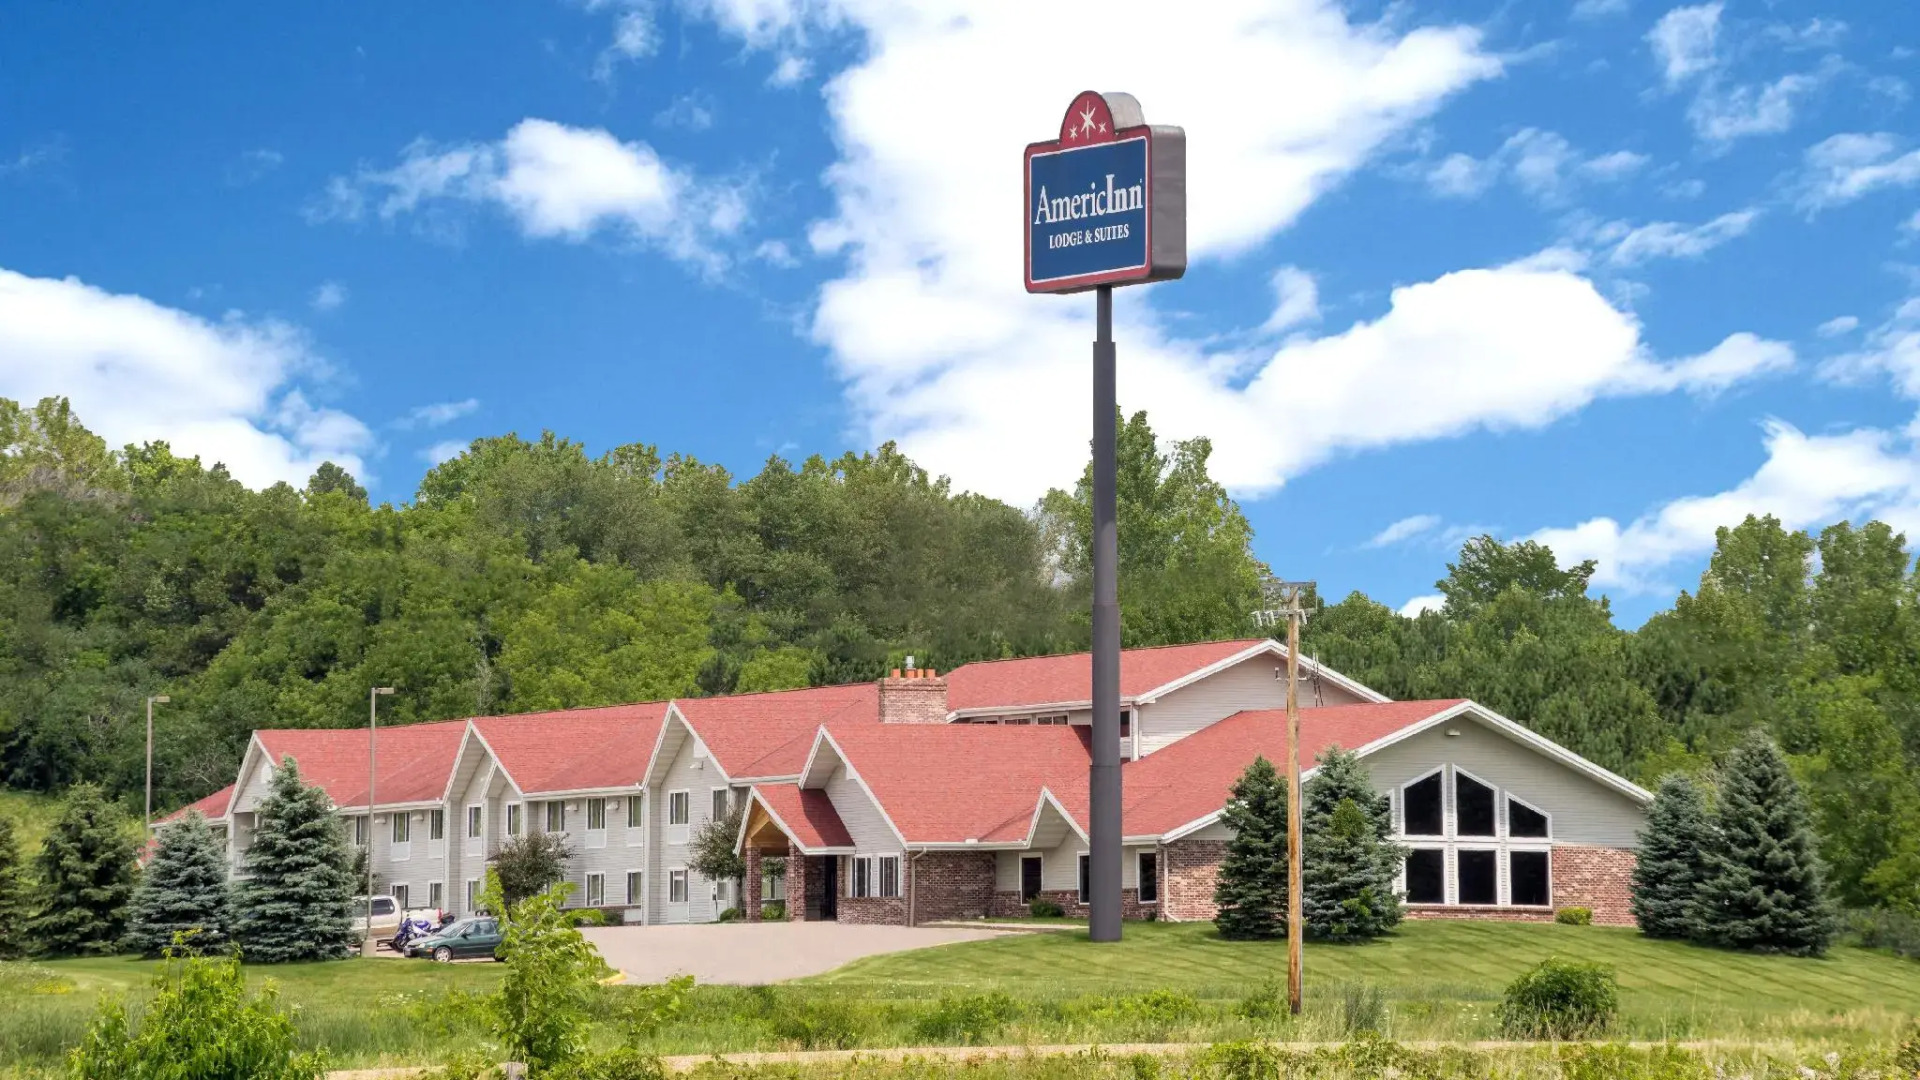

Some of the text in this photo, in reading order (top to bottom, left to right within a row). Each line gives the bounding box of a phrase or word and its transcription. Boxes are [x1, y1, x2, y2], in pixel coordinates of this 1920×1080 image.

[1034, 174, 1143, 224] AmericInn
[1049, 224, 1130, 249] LODGE & SUITES
